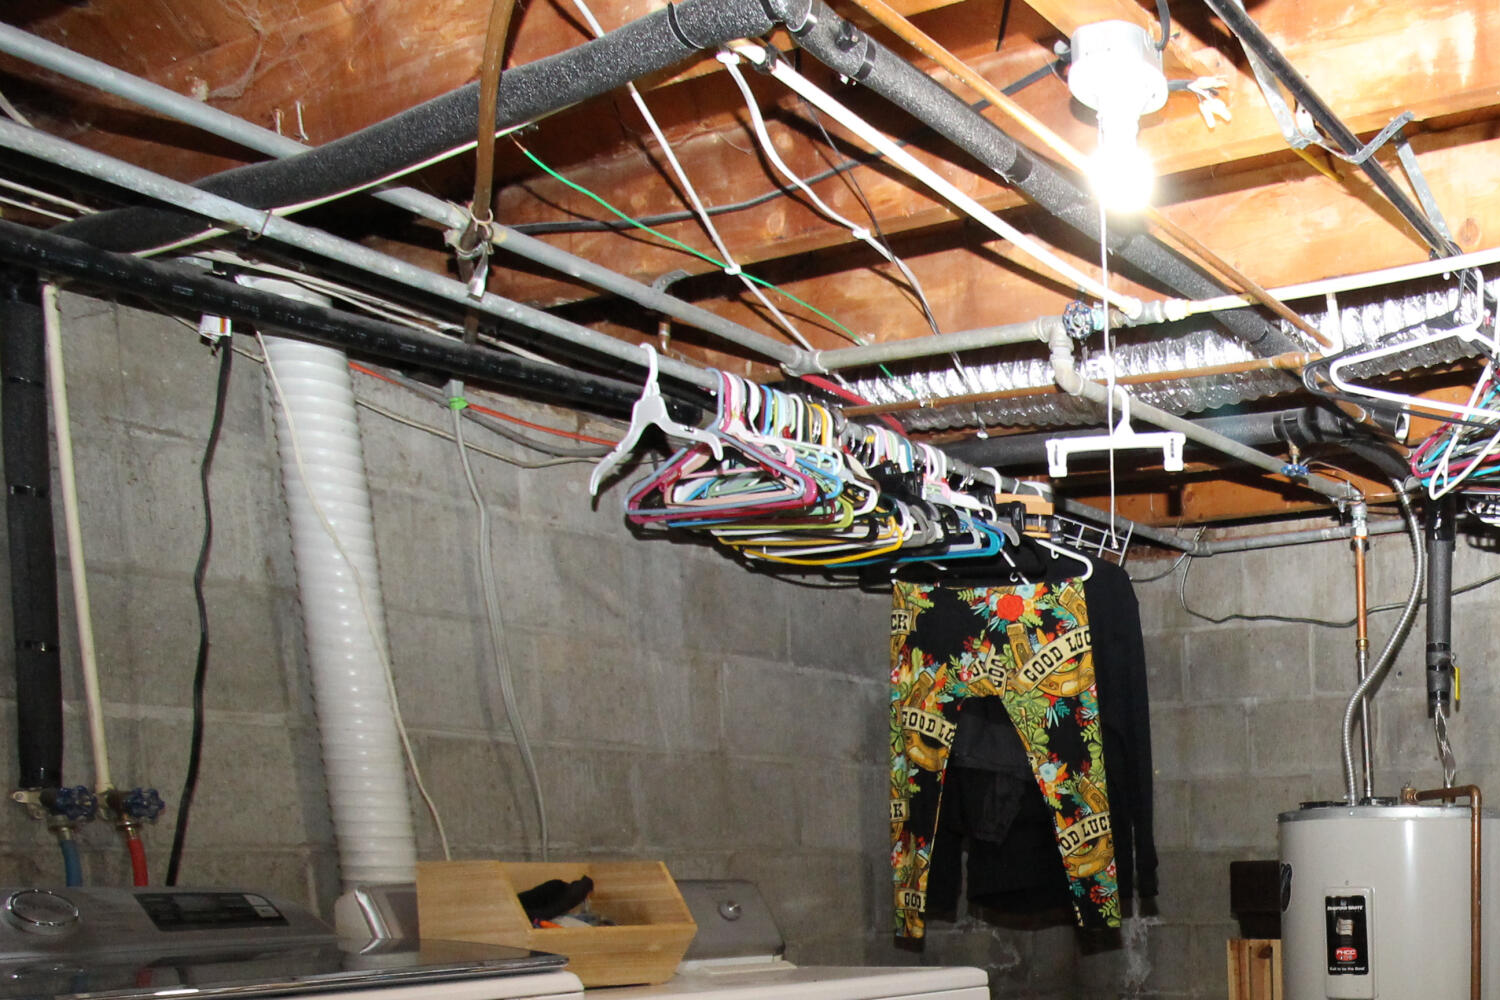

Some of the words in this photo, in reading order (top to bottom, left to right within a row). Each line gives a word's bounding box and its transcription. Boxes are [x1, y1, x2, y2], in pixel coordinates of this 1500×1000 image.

[1024, 646, 1064, 682] GOOD
[1070, 630, 1092, 652] LUC
[902, 711, 935, 733] GOOD
